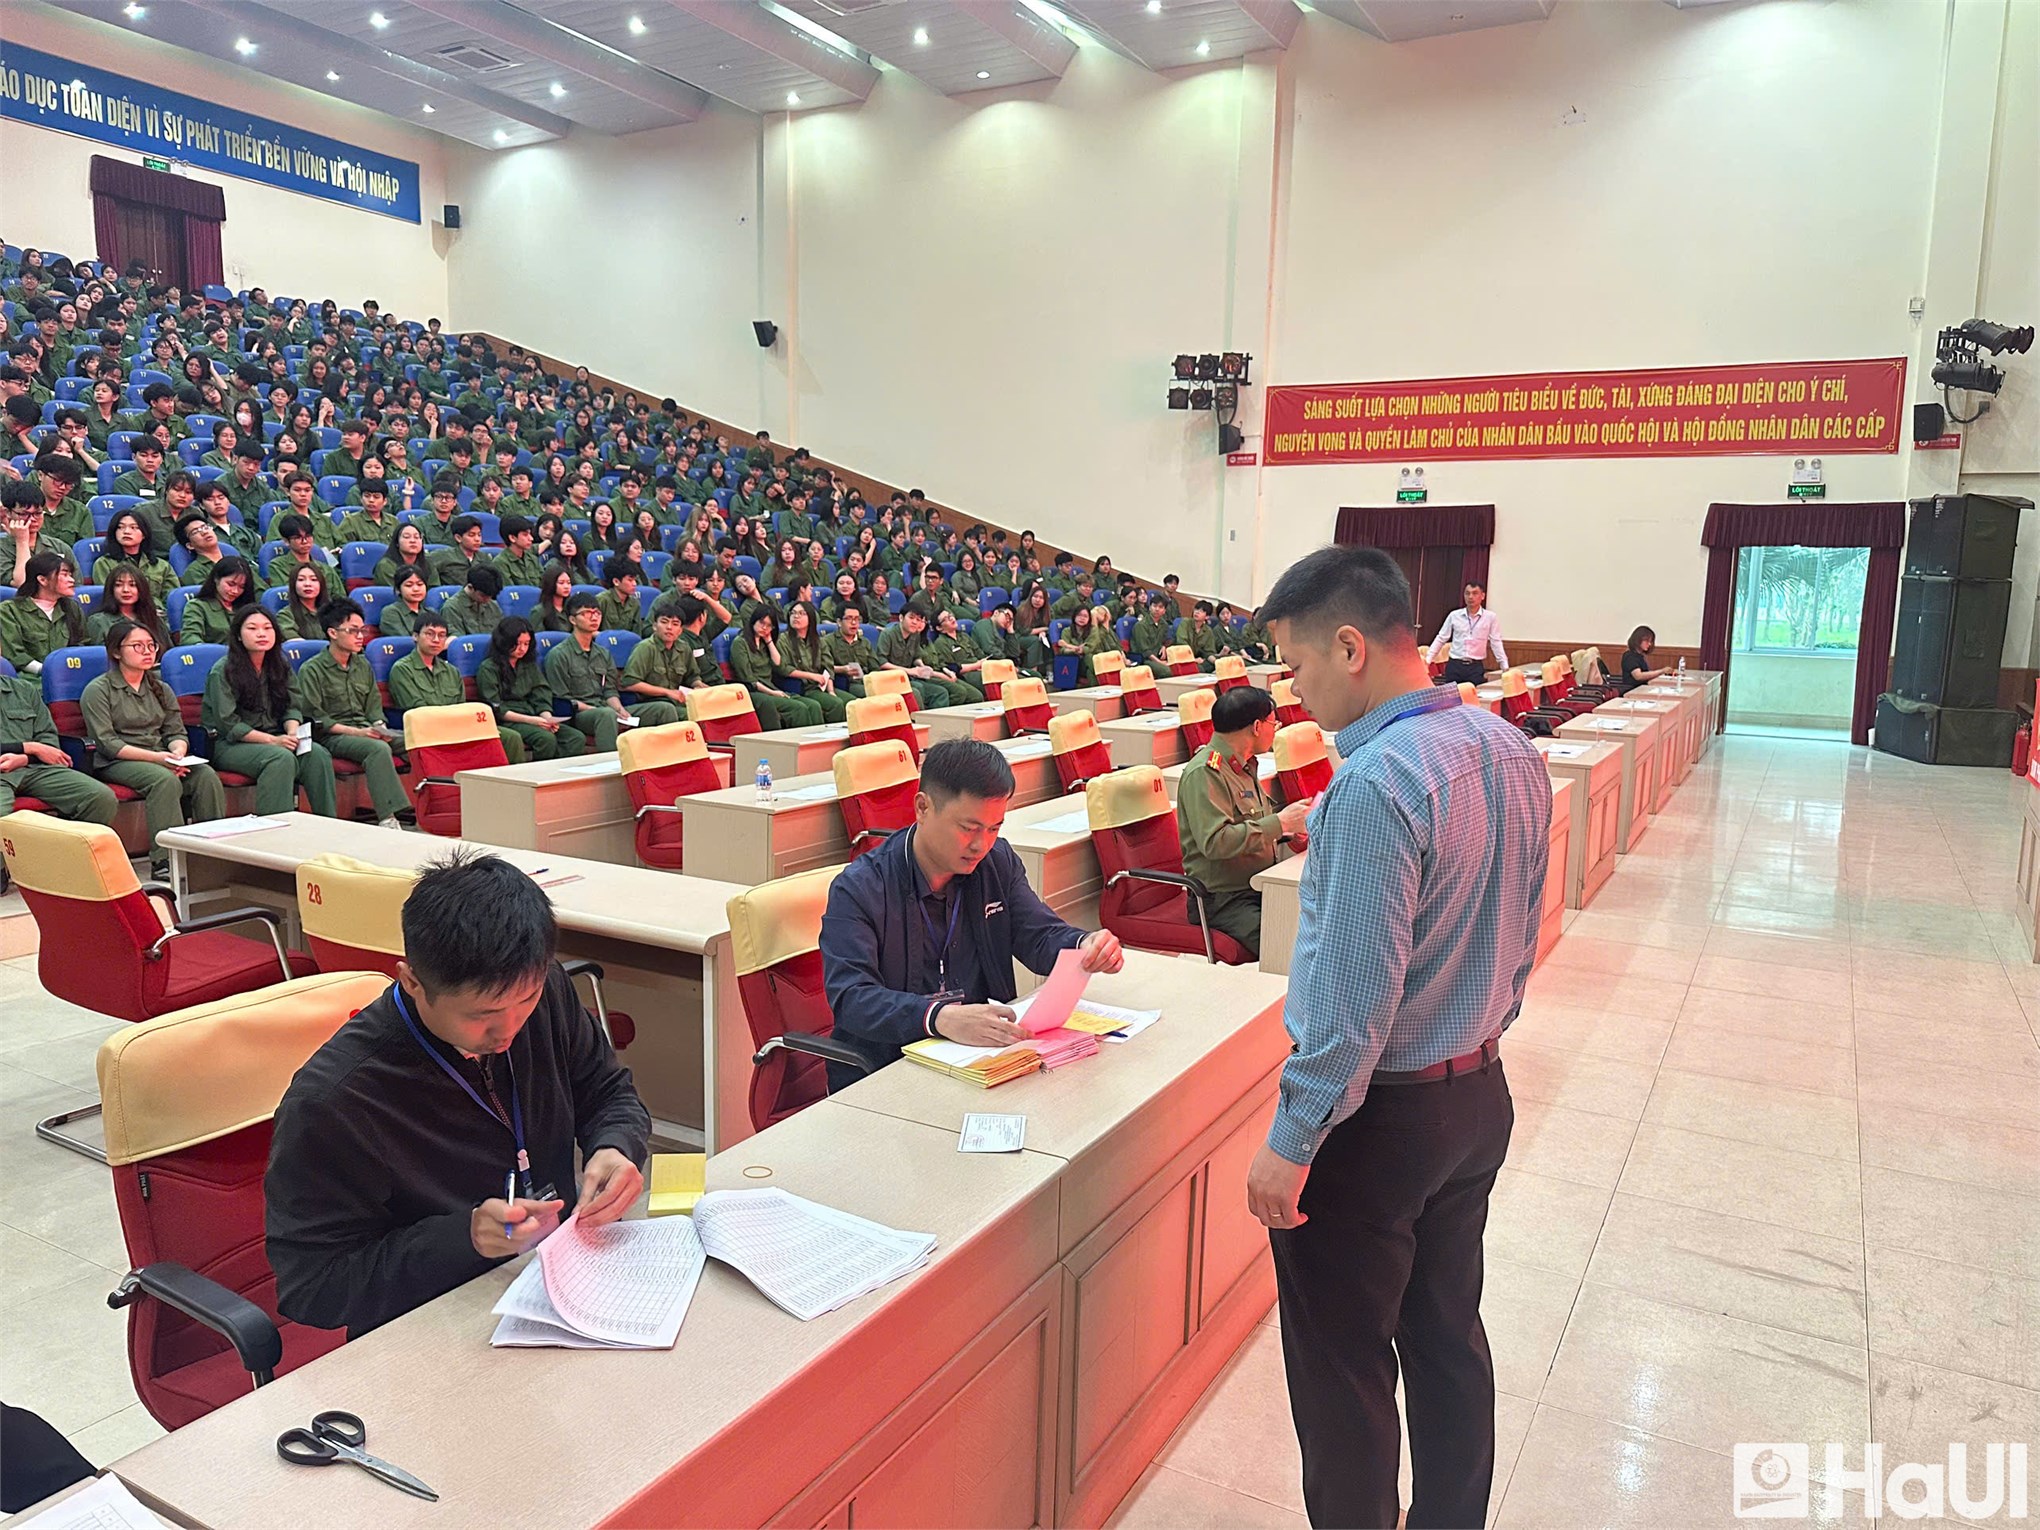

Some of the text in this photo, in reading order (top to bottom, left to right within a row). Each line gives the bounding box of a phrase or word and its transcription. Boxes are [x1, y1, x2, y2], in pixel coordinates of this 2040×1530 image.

[24, 73, 57, 114] DỤC
[107, 95, 141, 136] DIỆN
[145, 104, 160, 138] VÌ
[163, 111, 182, 150] SỰ
[186, 118, 220, 154] PHÁT
[224, 124, 262, 166] TRIỂN
[265, 135, 290, 173] BỀN
[294, 146, 327, 184] VỮNG
[348, 162, 366, 198] HỘI
[369, 170, 400, 206] NHẬP
[1304, 374, 1848, 421] SÁNG SUỐT LỰA CHỌN NHỮNG NGƯỜI TIÊU BIỂU VỀ ĐỨC, TÀI, XỨNG ĐÁNG ĐẠI DIỆN CHO Ý CHÍ,
[1274, 408, 1886, 455] NGUYỆN VỌNG VÀ QUYỀN LÀM CHỦ CỦA NHÂN DÂN BẦU VÀO QUỐC HỘI VÀ HỘI ĐỒNG NHÂN DÂN CÁC CẤP
[24, 460, 34, 468] 12
[103, 500, 114, 508] 12
[90, 544, 100, 552] 11
[274, 546, 284, 554] 13
[78, 594, 90, 604] 10
[278, 592, 288, 600] 12
[364, 594, 374, 602] 13
[510, 592, 519, 600] 15
[541, 638, 551, 647] 14
[608, 636, 618, 645] 15
[382, 645, 394, 654] 12
[463, 643, 474, 652] 13
[288, 650, 300, 659] 11
[66, 656, 81, 668] 09
[180, 654, 194, 666] 10
[1062, 666, 1069, 675] A
[736, 691, 744, 700] 63
[476, 712, 487, 722] 32
[686, 730, 696, 742] 62
[898, 750, 906, 762] 61
[1154, 778, 1162, 792] 01
[3, 838, 16, 857] 59
[308, 882, 322, 904] 28
